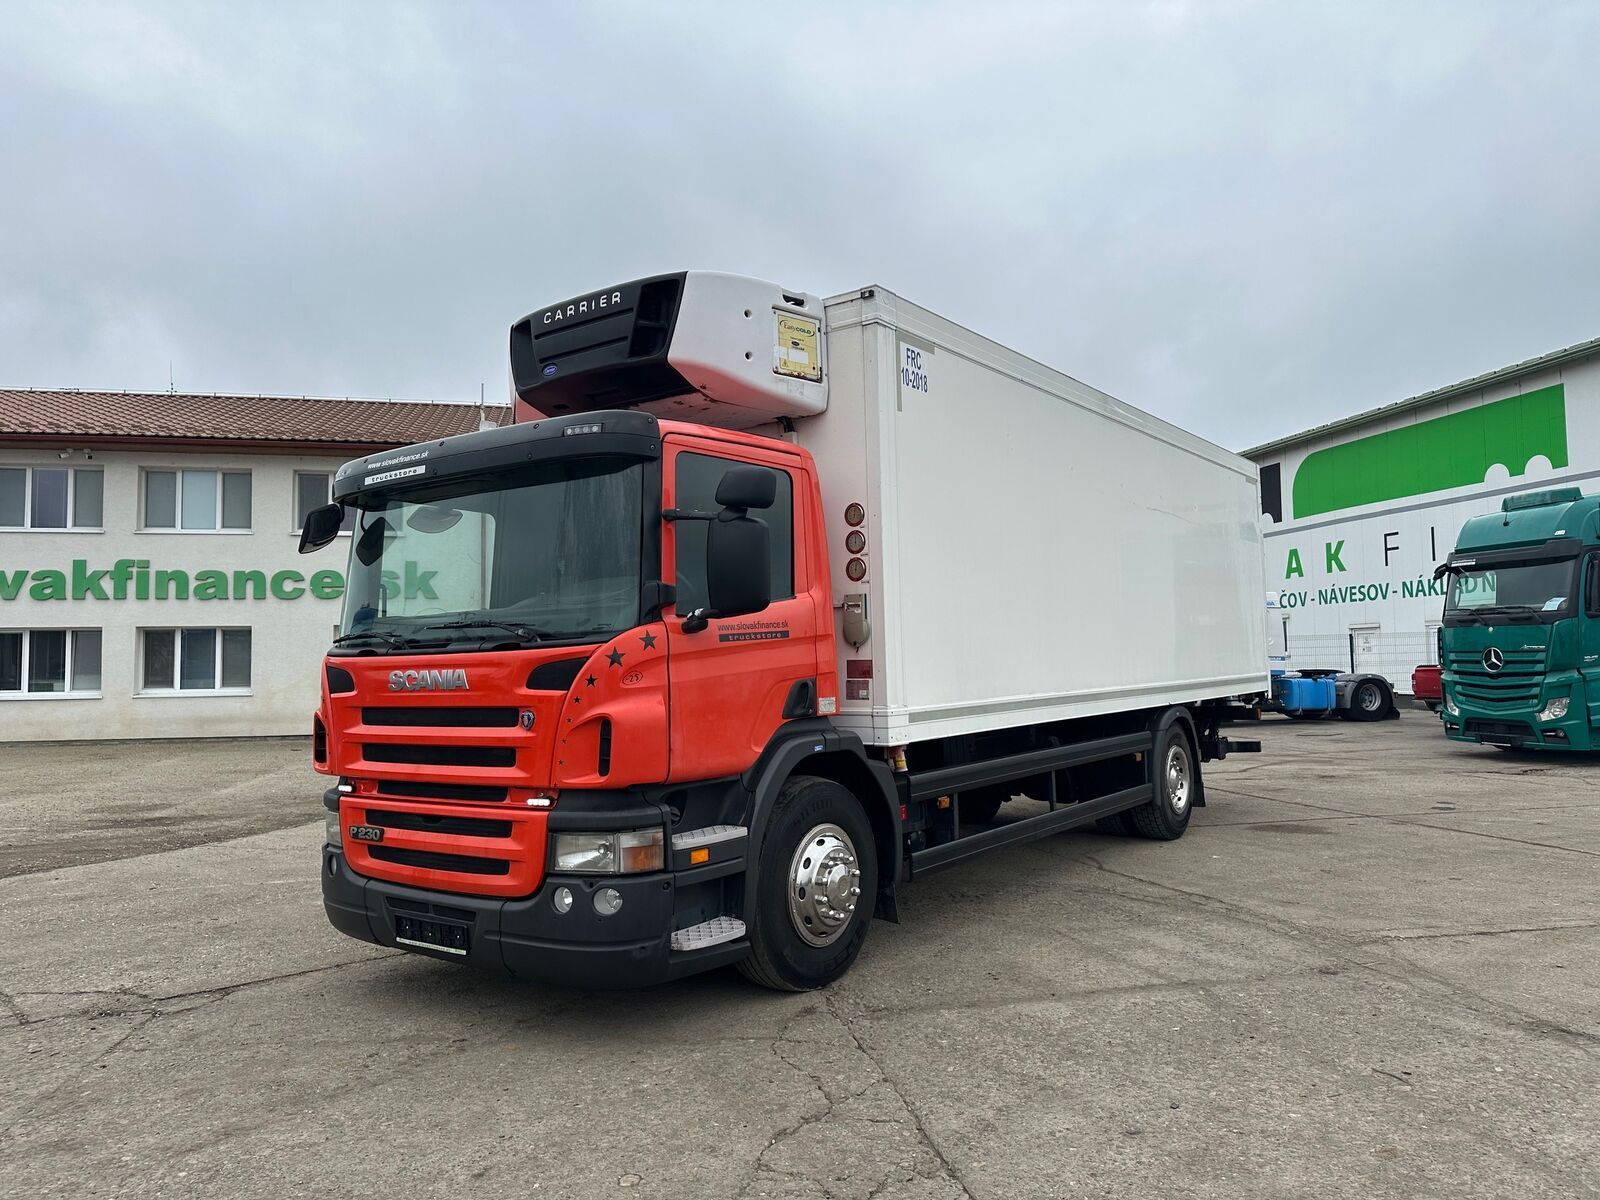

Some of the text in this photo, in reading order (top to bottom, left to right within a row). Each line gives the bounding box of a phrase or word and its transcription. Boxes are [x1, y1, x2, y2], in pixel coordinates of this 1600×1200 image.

[543, 291, 621, 324] CARRIER
[906, 347, 922, 370] FRC
[901, 366, 928, 393] 10-2018
[367, 450, 430, 469] www.slovakfinance.sk
[371, 469, 418, 483] truckstore
[717, 620, 789, 631] www.slovakfinance.sk
[728, 633, 782, 641] truckstore
[388, 668, 470, 691] SCANIA
[350, 826, 381, 841] P 230
